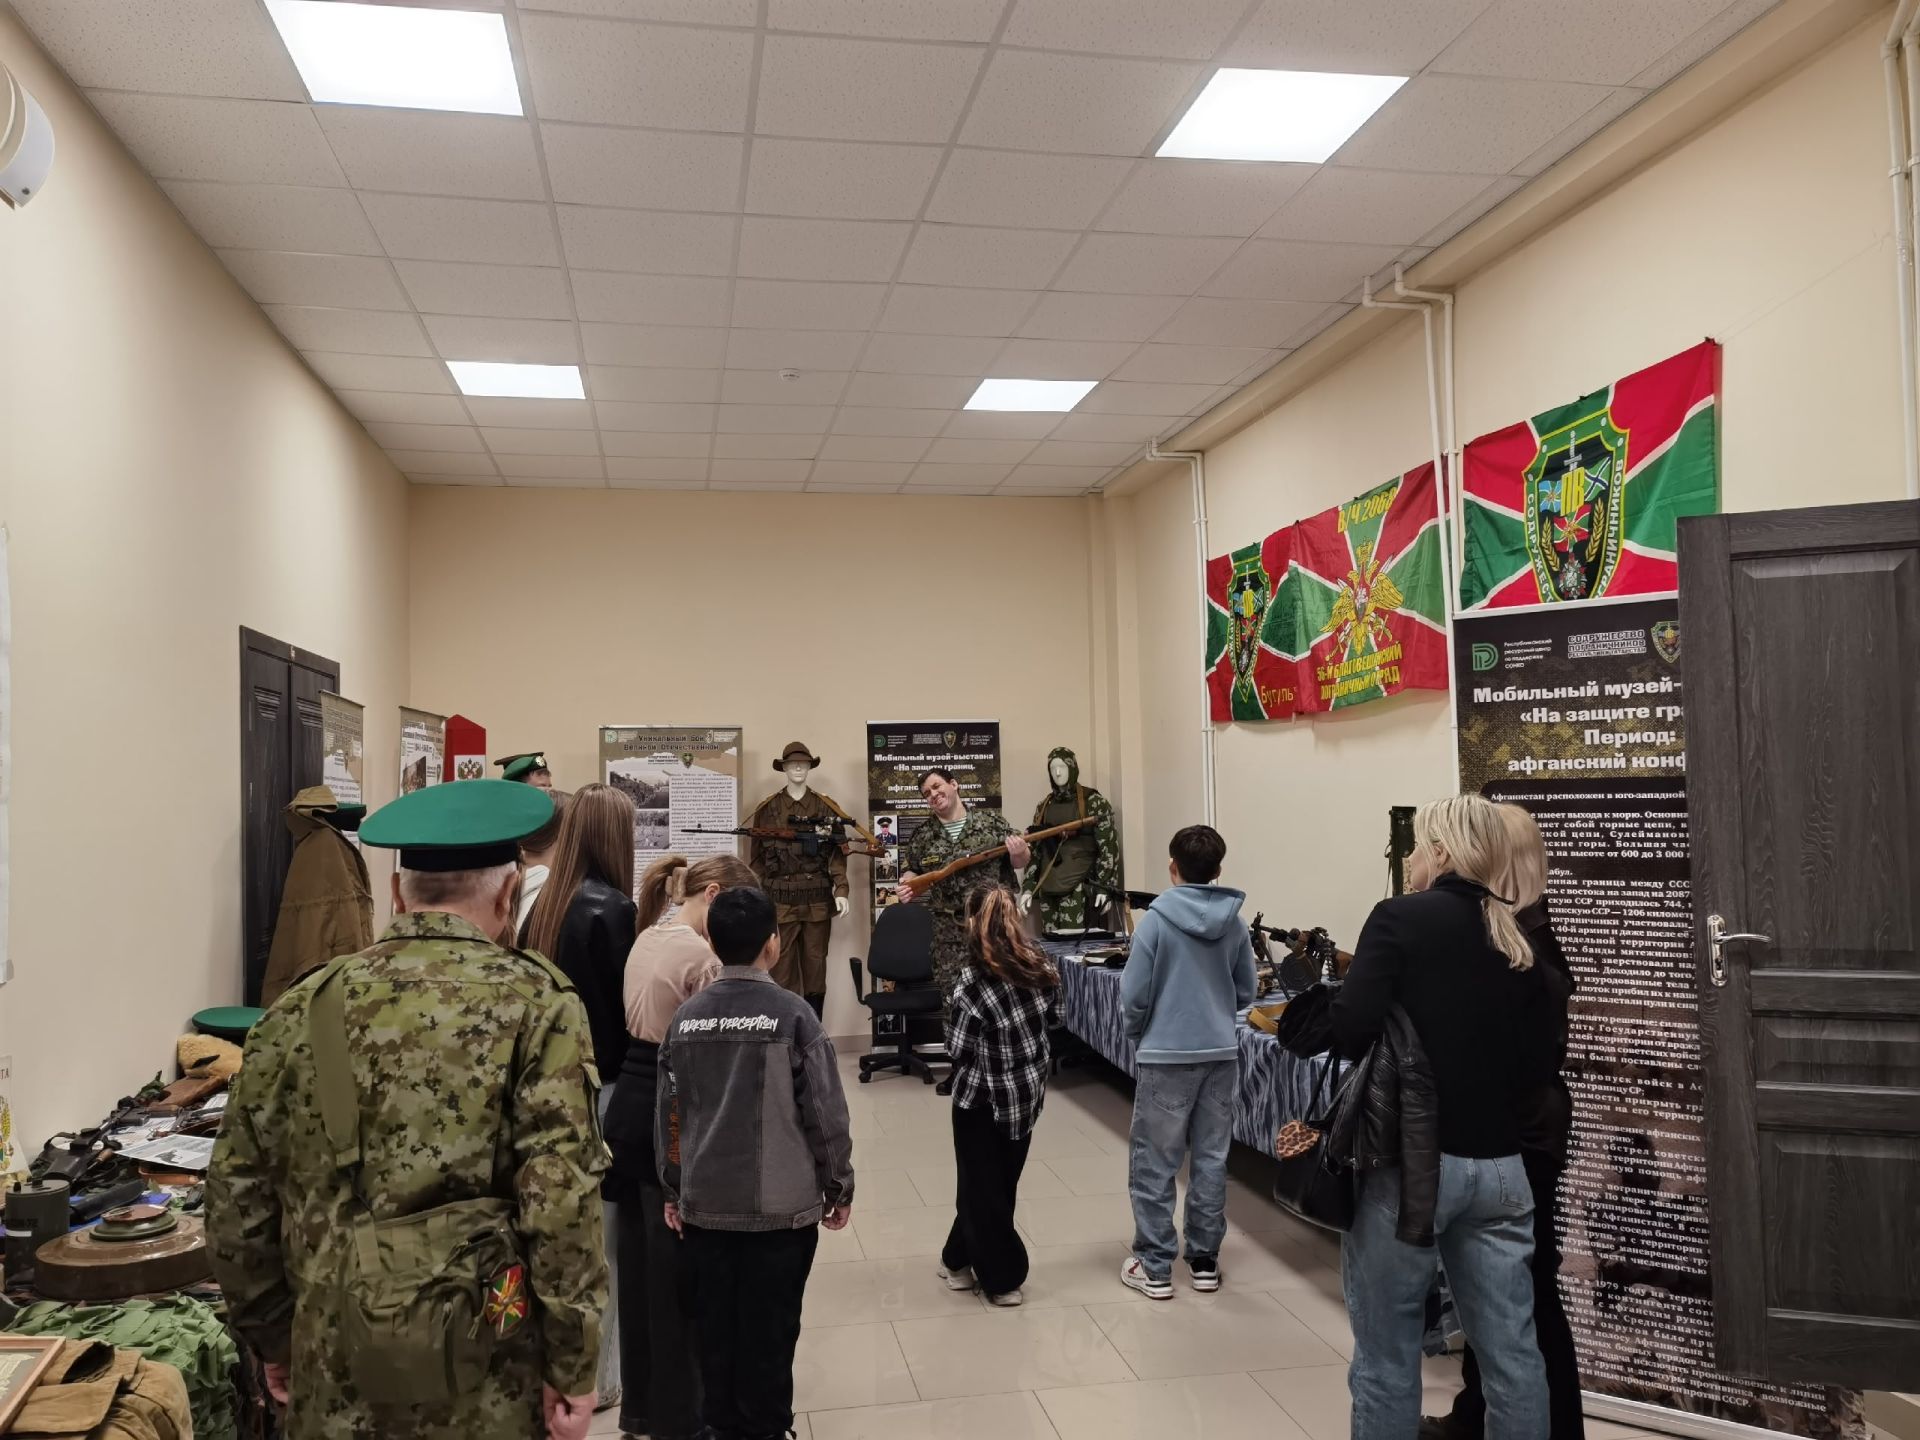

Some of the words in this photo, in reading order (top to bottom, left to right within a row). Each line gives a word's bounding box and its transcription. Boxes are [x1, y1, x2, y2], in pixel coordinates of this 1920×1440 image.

[1594, 459, 1624, 599] ГРАНИЧНИКОВ
[1568, 629, 1645, 644] СОДРУЖЕСТВО
[1568, 640, 1646, 653] ПОГРАНИЧНИКОВ
[1473, 681, 1599, 703] Мобильный
[1604, 677, 1682, 699] музей-
[1520, 707, 1560, 723] «На
[1566, 705, 1650, 725] защите
[1656, 706, 1683, 722] гр
[1584, 730, 1676, 747] Период:
[874, 753, 924, 762] Мобильный
[1508, 753, 1626, 774] афганский
[1491, 793, 1544, 802] Афганистан
[1546, 793, 1604, 801] расположен
[1615, 791, 1685, 799] юго-западной
[1612, 812, 1643, 820] морю.
[1564, 820, 1595, 828] собой
[1571, 831, 1604, 839] цепи,
[1621, 890, 1650, 898] запад
[1574, 897, 1593, 905] ССР
[1596, 899, 1661, 907] приходилось
[1591, 907, 1611, 915] ССР
[1622, 908, 1645, 916] 1206
[1623, 920, 1688, 928] участвовали
[1556, 925, 1576, 933] 40-й
[1578, 927, 1610, 935] армии
[1646, 930, 1676, 938] после
[1620, 939, 1684, 949] территории
[1582, 945, 1616, 954] банды
[1620, 949, 1693, 958] мятежников:
[1601, 957, 1674, 967] зверствовали
[1602, 966, 1651, 977] Доходило
[1584, 976, 1662, 987] изуродованные
[1581, 985, 1610, 993] поток
[1611, 987, 1649, 996] прибил
[719, 1013, 778, 1032] PERCEPTION
[1589, 1053, 1616, 1062] были
[1621, 1056, 1683, 1069] поставлены
[1582, 1073, 1632, 1084] пропуск
[1637, 1079, 1673, 1089] войск
[1624, 1097, 1681, 1109] прикрыть
[1602, 1143, 1649, 1155] обстрел
[1565, 1158, 1633, 1173] еобходимую
